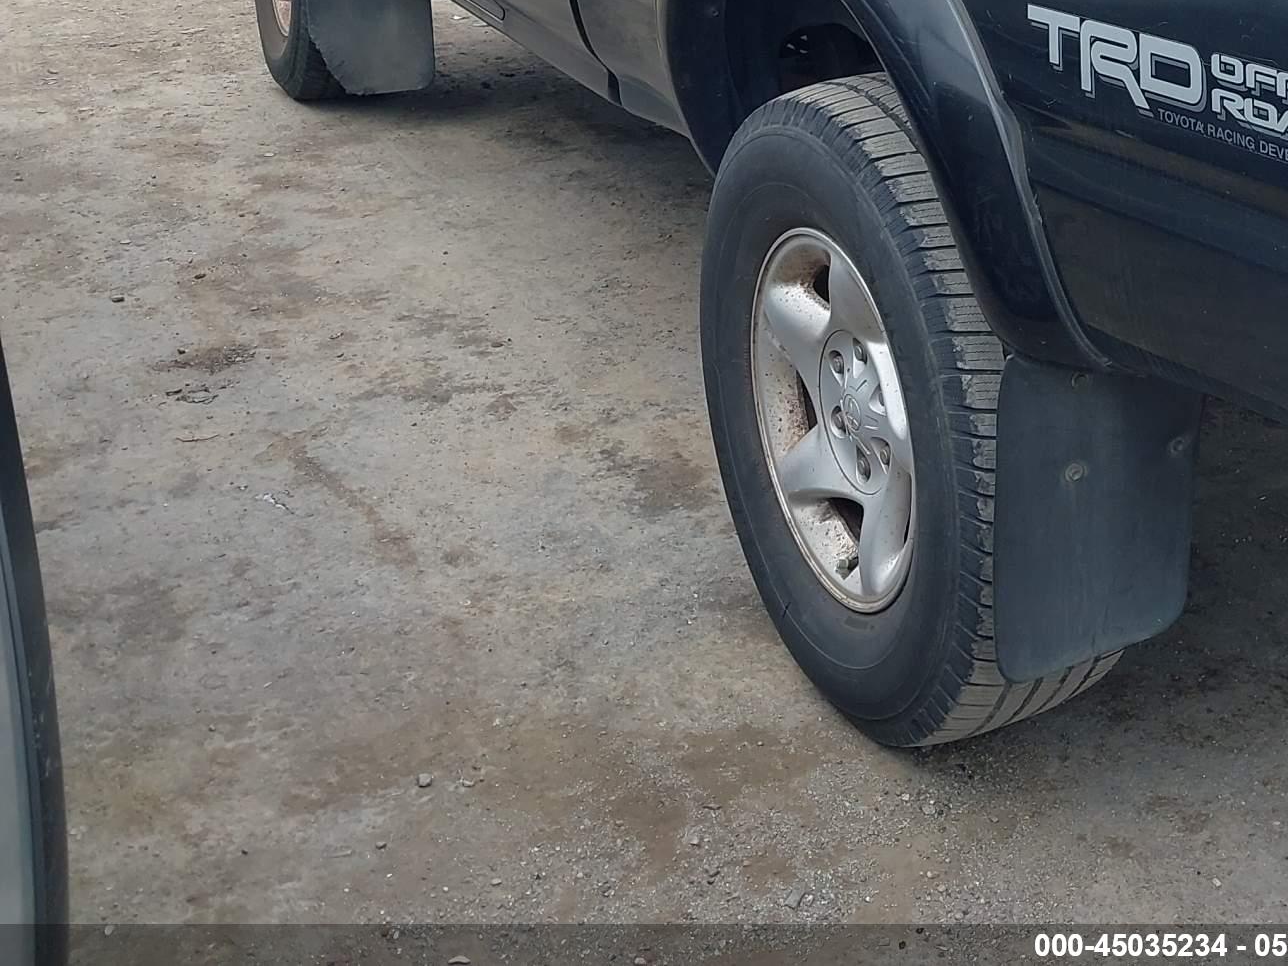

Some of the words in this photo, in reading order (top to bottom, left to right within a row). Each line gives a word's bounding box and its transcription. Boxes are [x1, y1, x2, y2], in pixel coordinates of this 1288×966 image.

[1027, 4, 1207, 116] TRD
[1157, 108, 1205, 135] TOYOTA
[1206, 122, 1256, 151] RACING
